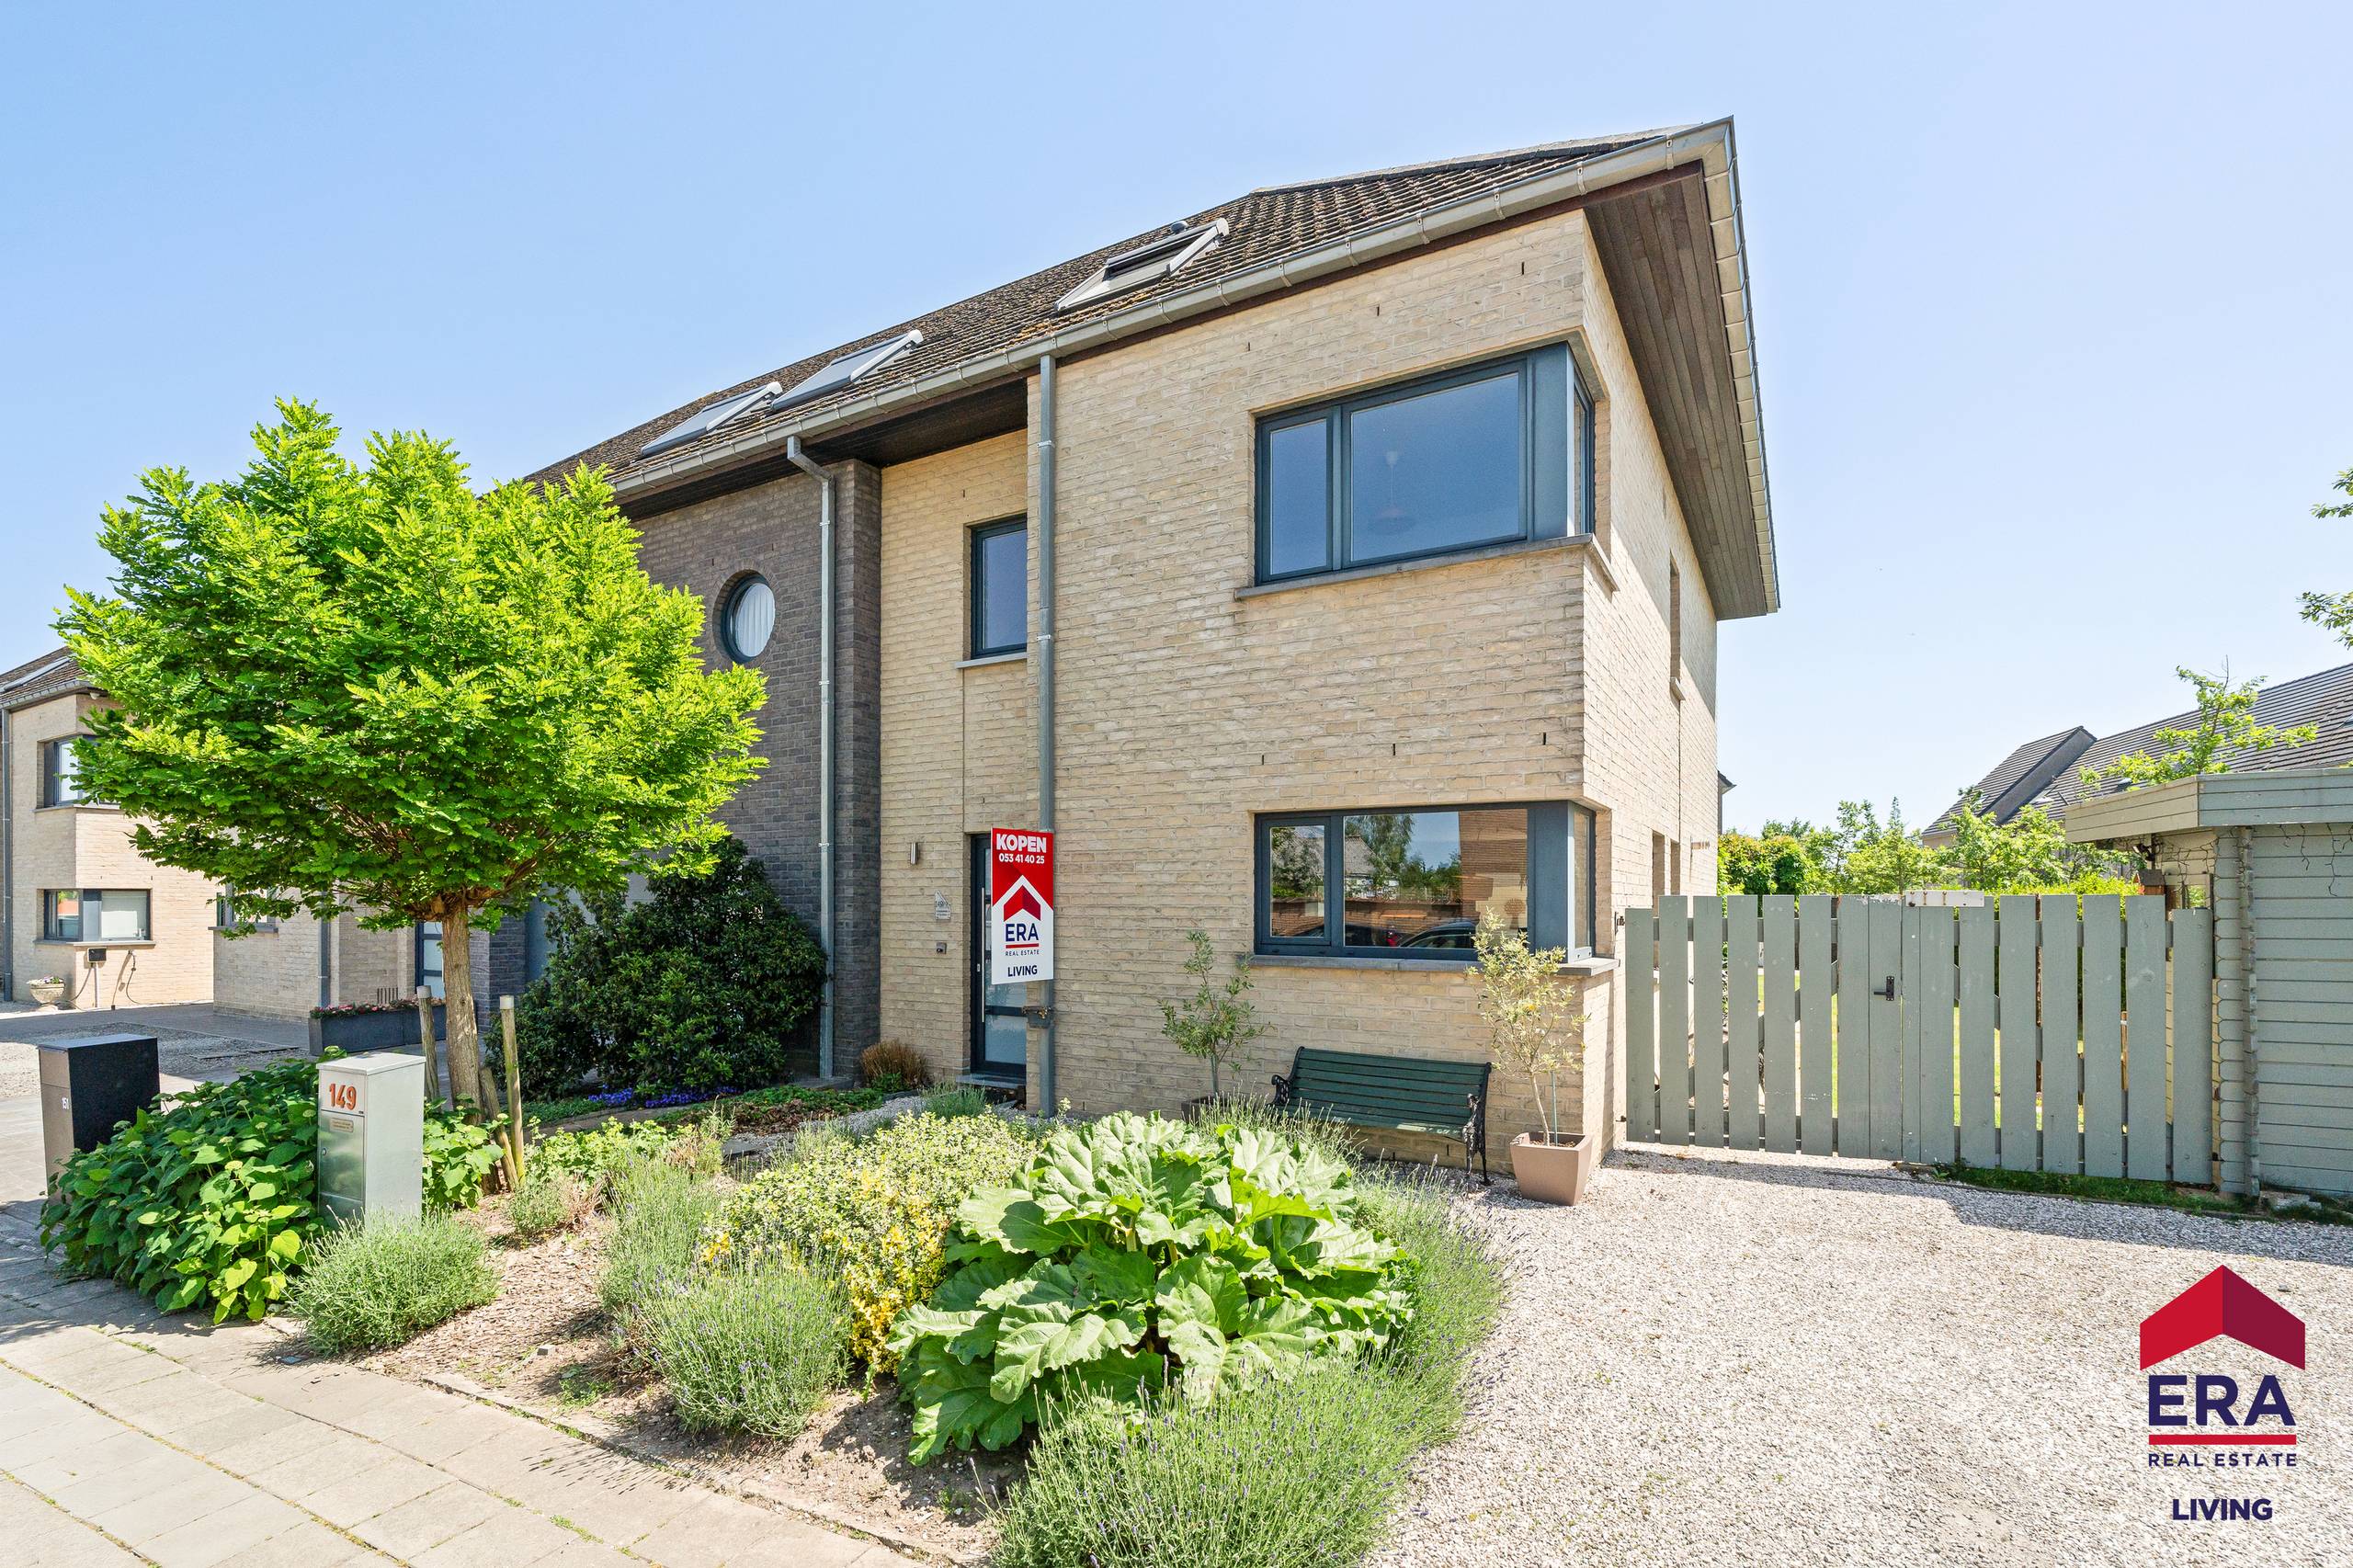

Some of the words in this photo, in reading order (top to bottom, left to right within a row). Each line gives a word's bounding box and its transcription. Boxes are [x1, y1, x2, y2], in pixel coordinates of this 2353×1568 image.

[996, 833, 1047, 853] KOPEN
[999, 853, 1014, 862] 053
[1015, 854, 1023, 863] 41
[1025, 855, 1035, 864] 40
[1036, 855, 1045, 864] 25
[1005, 923, 1040, 941] ERA
[1007, 965, 1038, 977] LIVING
[329, 1084, 357, 1110] 149
